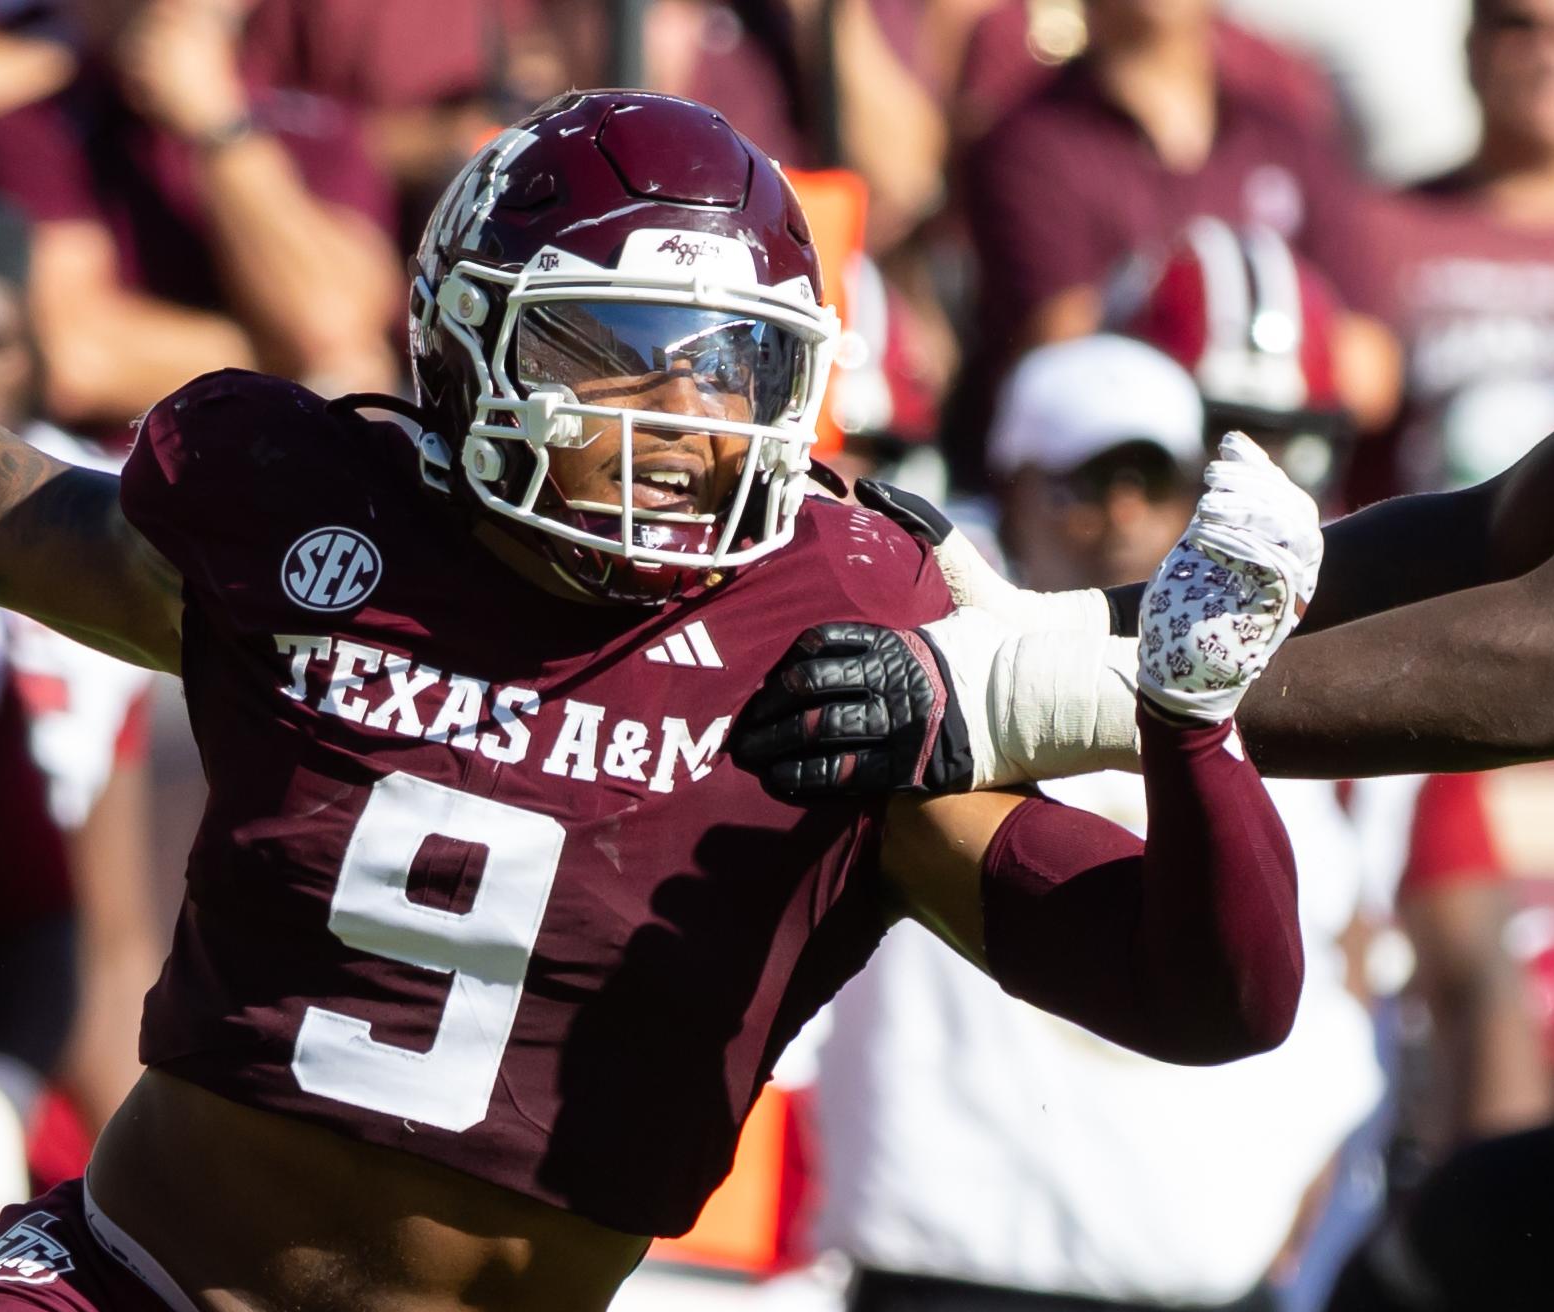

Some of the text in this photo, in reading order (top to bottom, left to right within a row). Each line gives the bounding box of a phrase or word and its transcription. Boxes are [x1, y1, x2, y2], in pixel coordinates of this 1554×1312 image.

[657, 234, 722, 266] Aggi
[287, 530, 375, 606] SEC
[273, 634, 732, 793] TEXAS A&M
[291, 770, 567, 1133] 9
